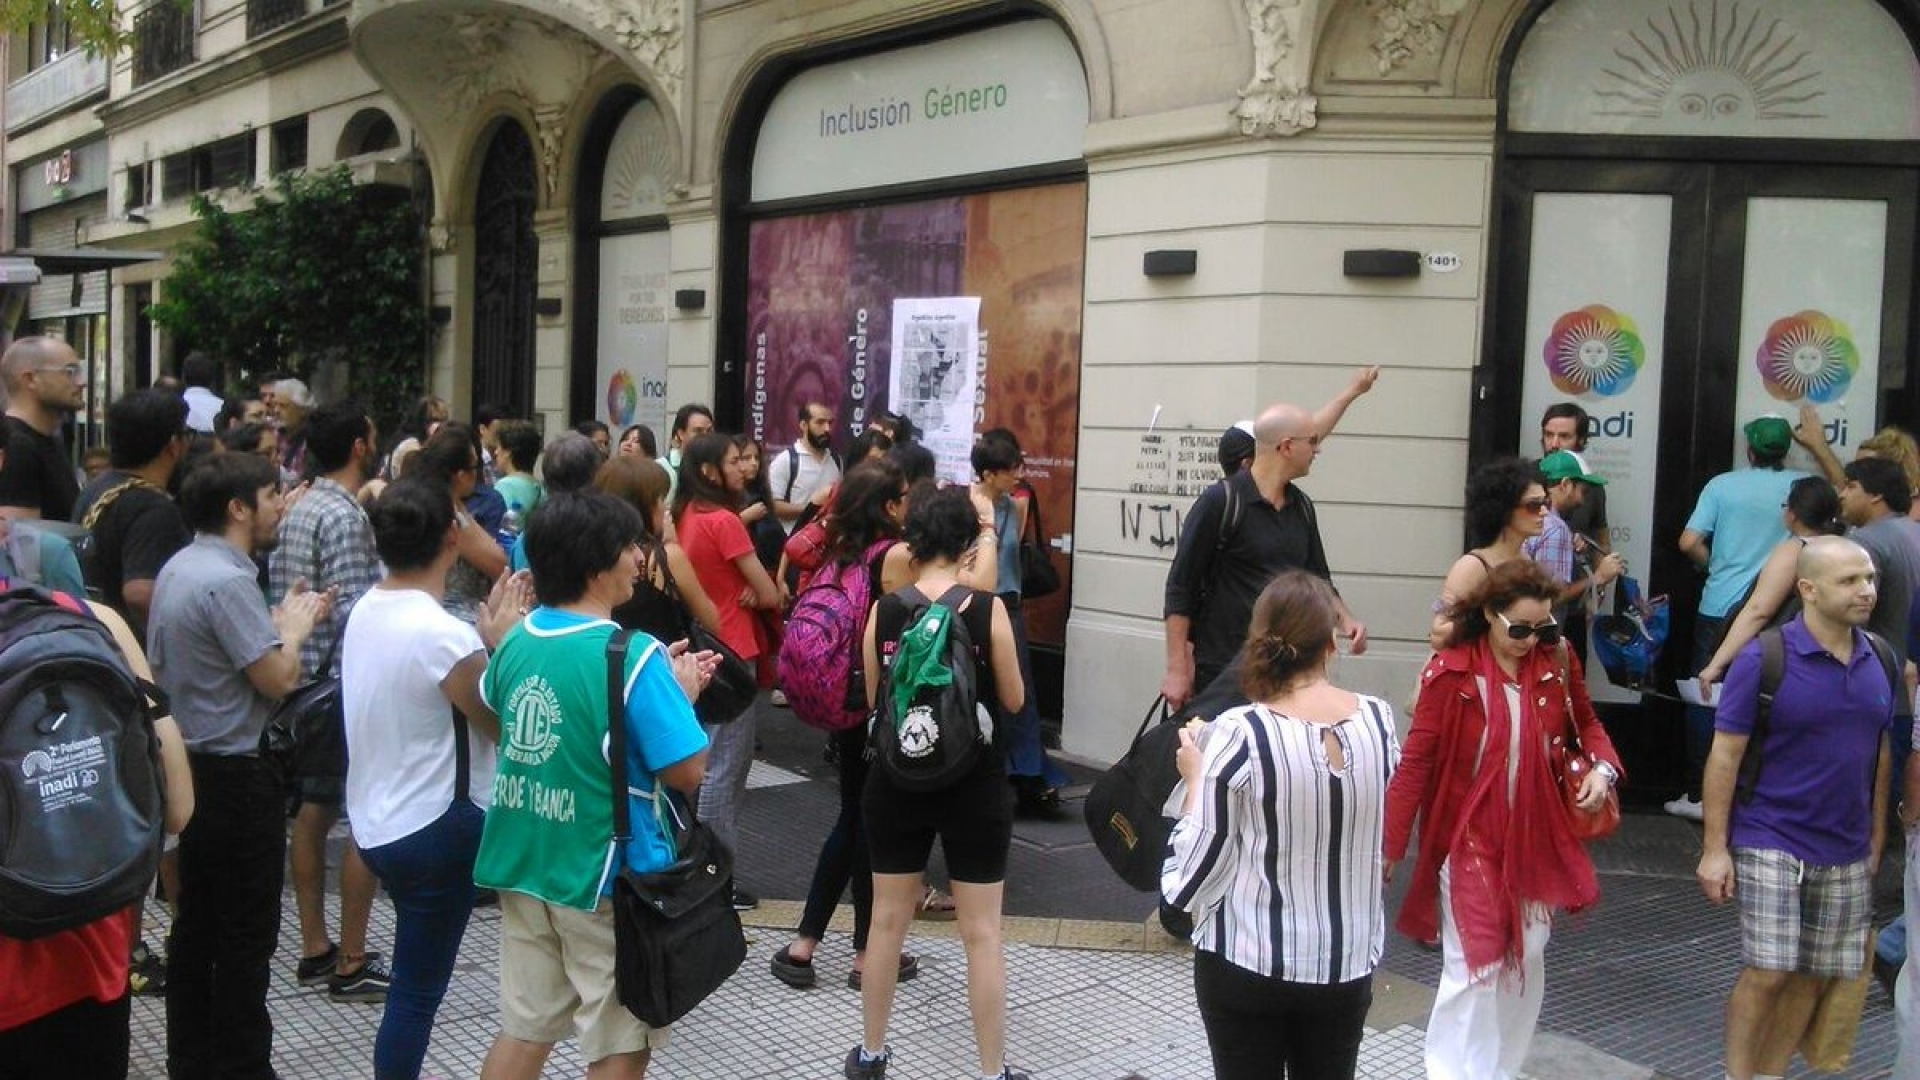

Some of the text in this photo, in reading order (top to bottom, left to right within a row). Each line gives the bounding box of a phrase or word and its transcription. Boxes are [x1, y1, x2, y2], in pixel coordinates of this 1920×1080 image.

[820, 84, 1007, 137] Inclusión Género
[1428, 255, 1457, 267] 1401
[642, 376, 668, 398] ina
[750, 332, 768, 441] ndígenas
[850, 407, 865, 438] de
[39, 772, 78, 798] inadi
